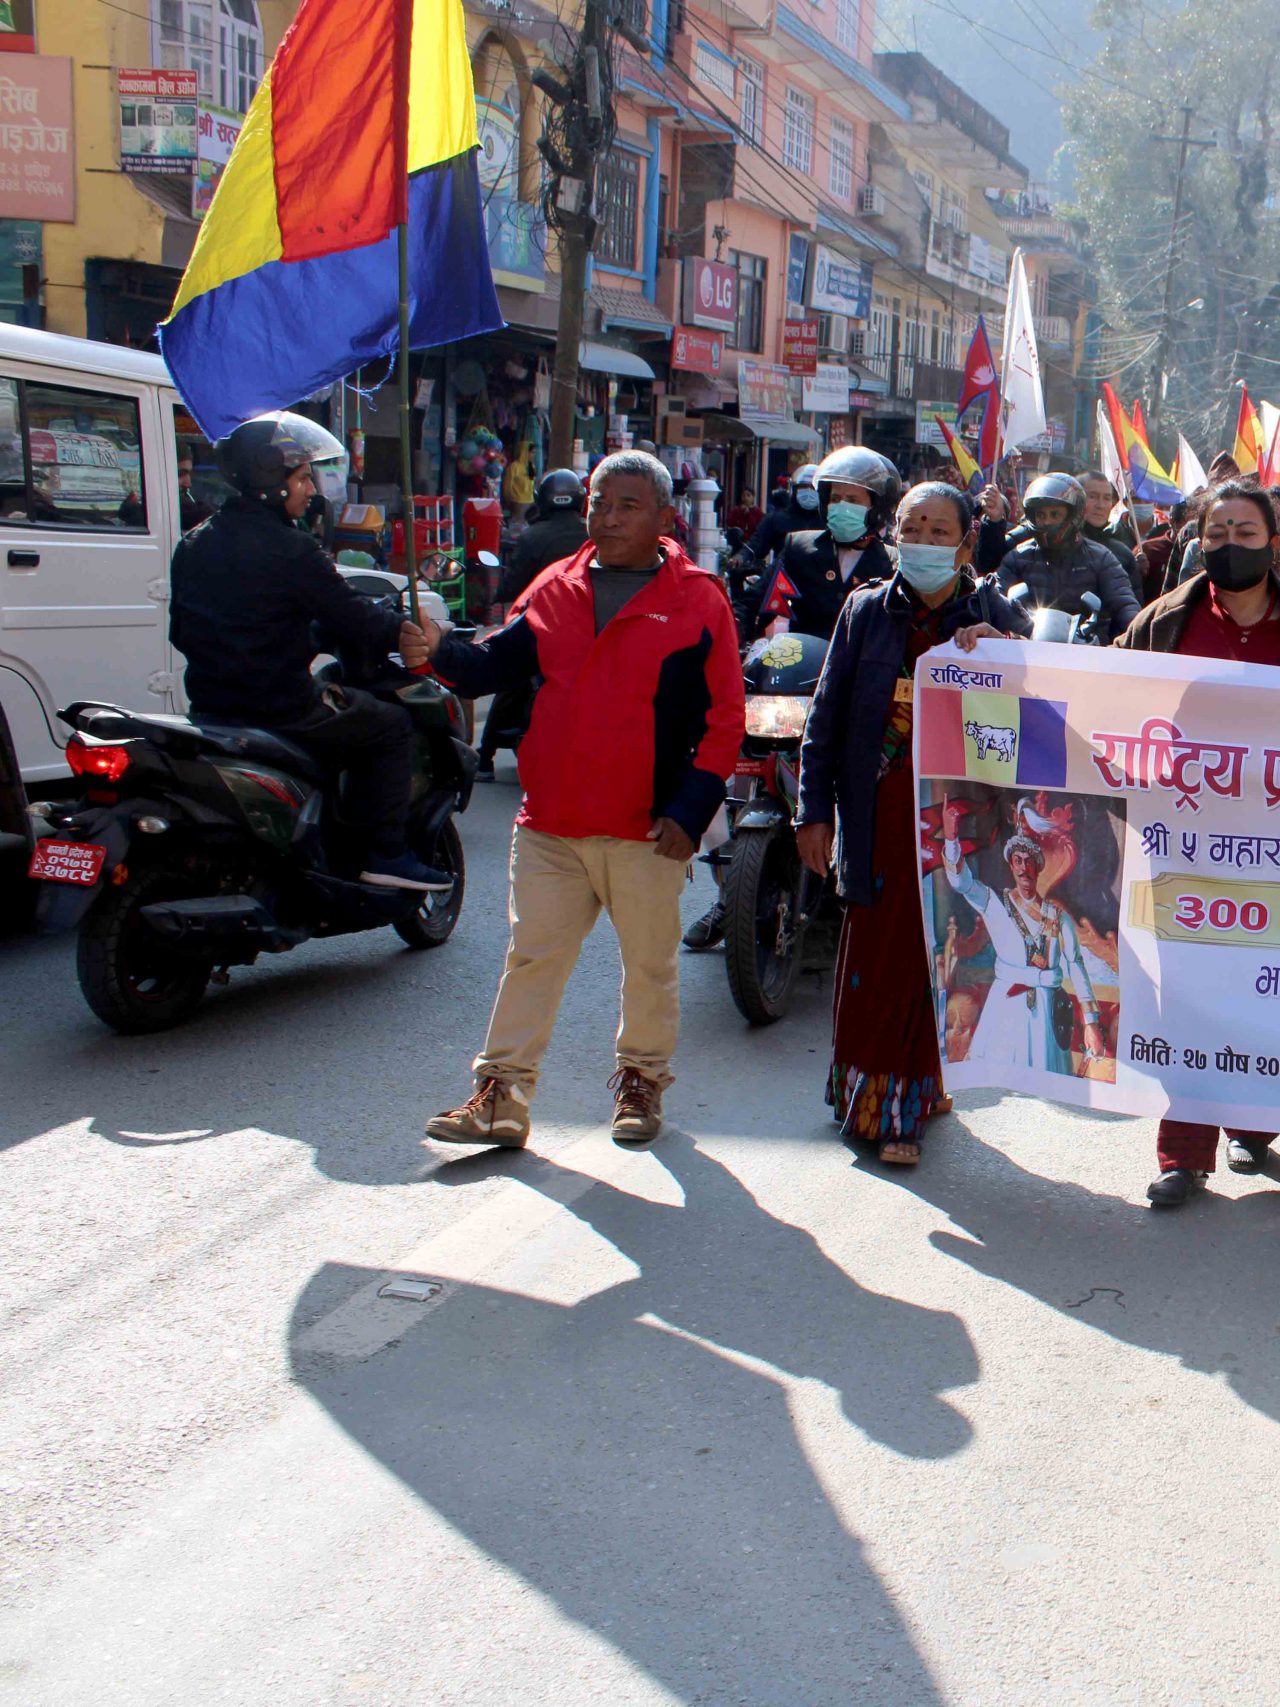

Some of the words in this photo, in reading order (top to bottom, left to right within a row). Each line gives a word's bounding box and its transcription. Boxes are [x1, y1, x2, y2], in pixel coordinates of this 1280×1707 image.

[716, 275, 732, 309] LG
[931, 664, 1002, 690] राष्ट्रियता
[1092, 720, 1249, 810] राष्ट्रिय
[1143, 823, 1170, 856] श्री
[1181, 832, 1197, 862] ५
[1175, 897, 1268, 930] ३००
[1183, 1048, 1207, 1070] २७
[1215, 1046, 1250, 1073] पौष
